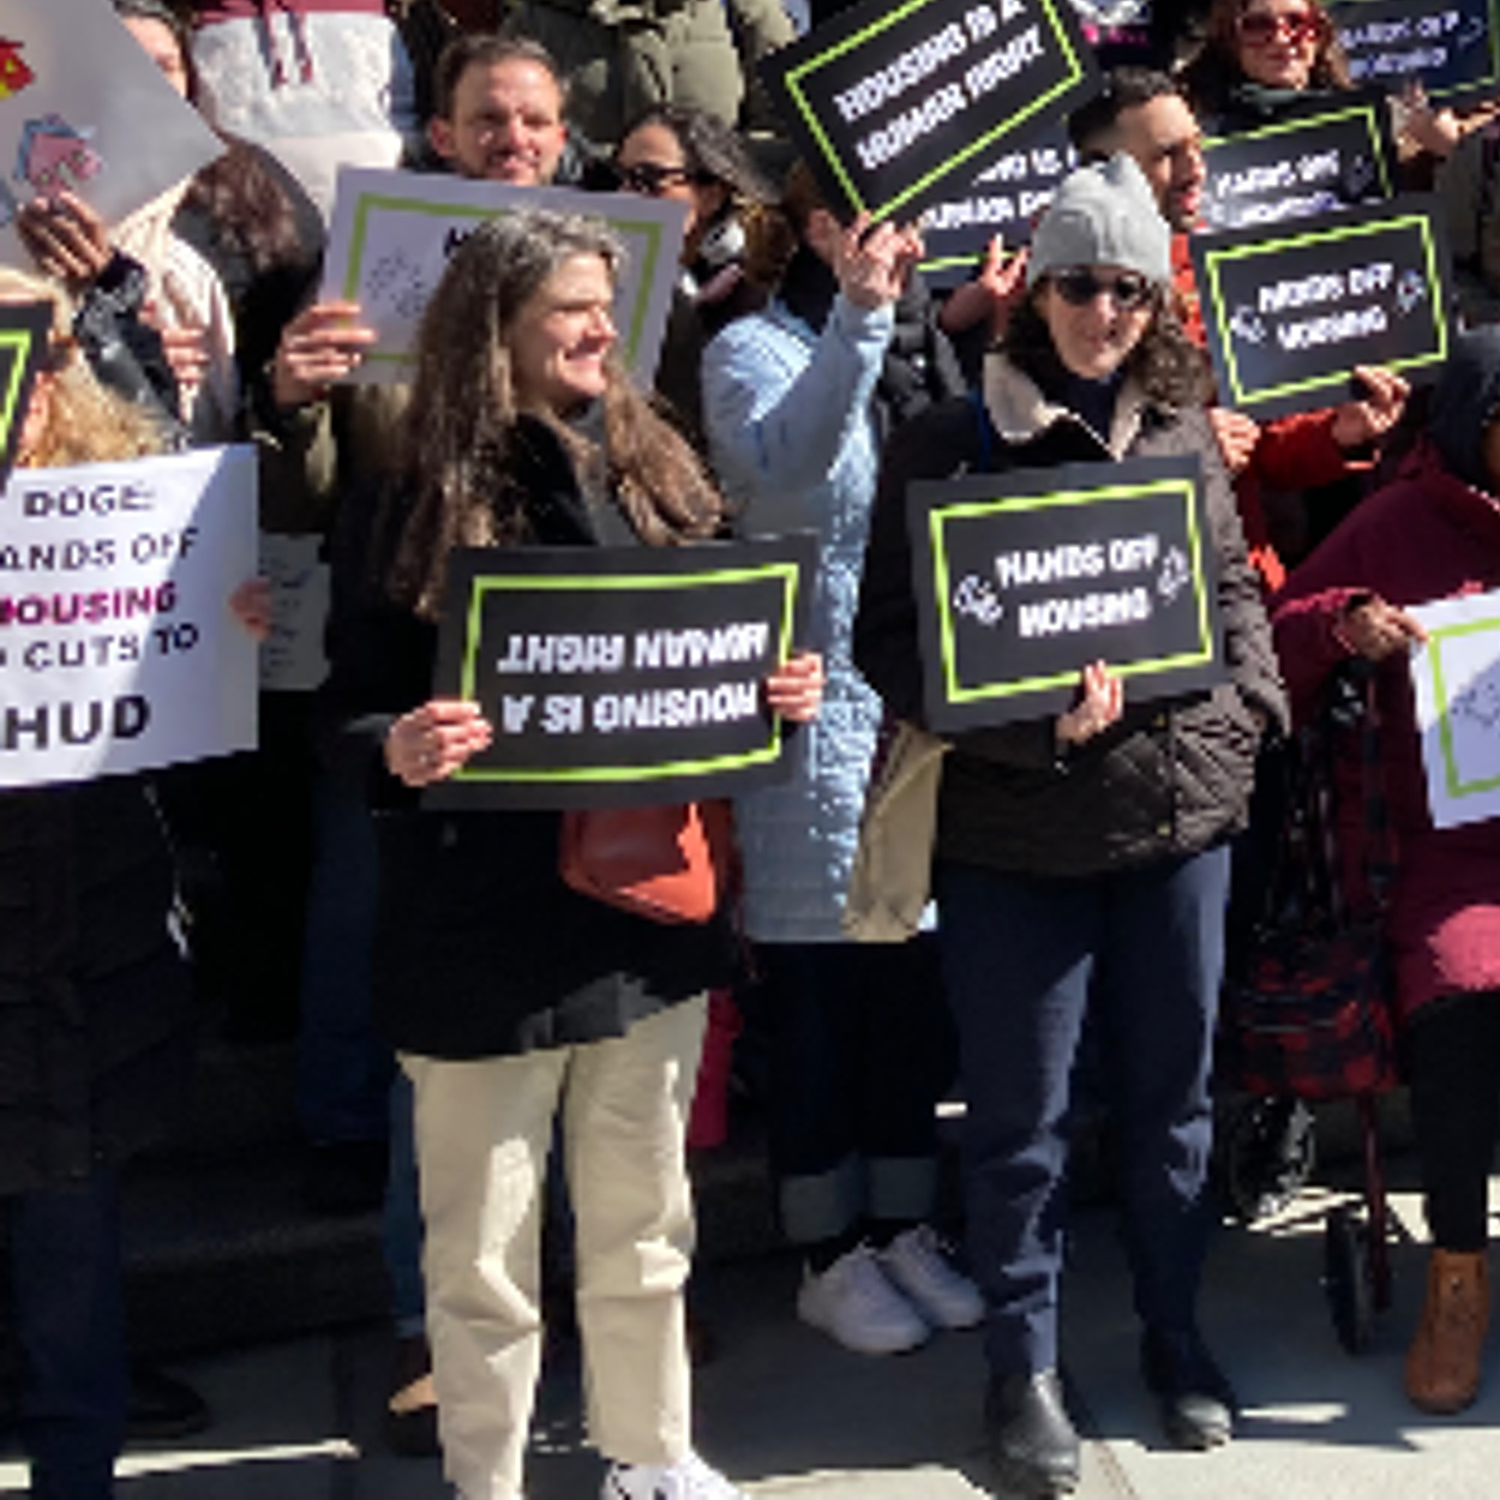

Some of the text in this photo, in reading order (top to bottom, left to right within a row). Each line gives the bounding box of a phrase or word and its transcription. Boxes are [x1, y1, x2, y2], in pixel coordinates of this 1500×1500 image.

[834, 23, 967, 122] HOUSING
[963, 4, 998, 40] IS
[855, 81, 966, 170] HUMAN
[964, 25, 1047, 98] RIGHT
[23, 485, 152, 518] DOGE
[0, 527, 198, 571] ANDS OFF
[996, 534, 1158, 587] HANDS OFF
[1018, 587, 1152, 637] HOUSING
[23, 623, 199, 672] CUTS TO
[498, 623, 769, 674] HUMAN RIGHT
[3, 696, 151, 750] HUD
[502, 682, 757, 732] HOUSING IS A
